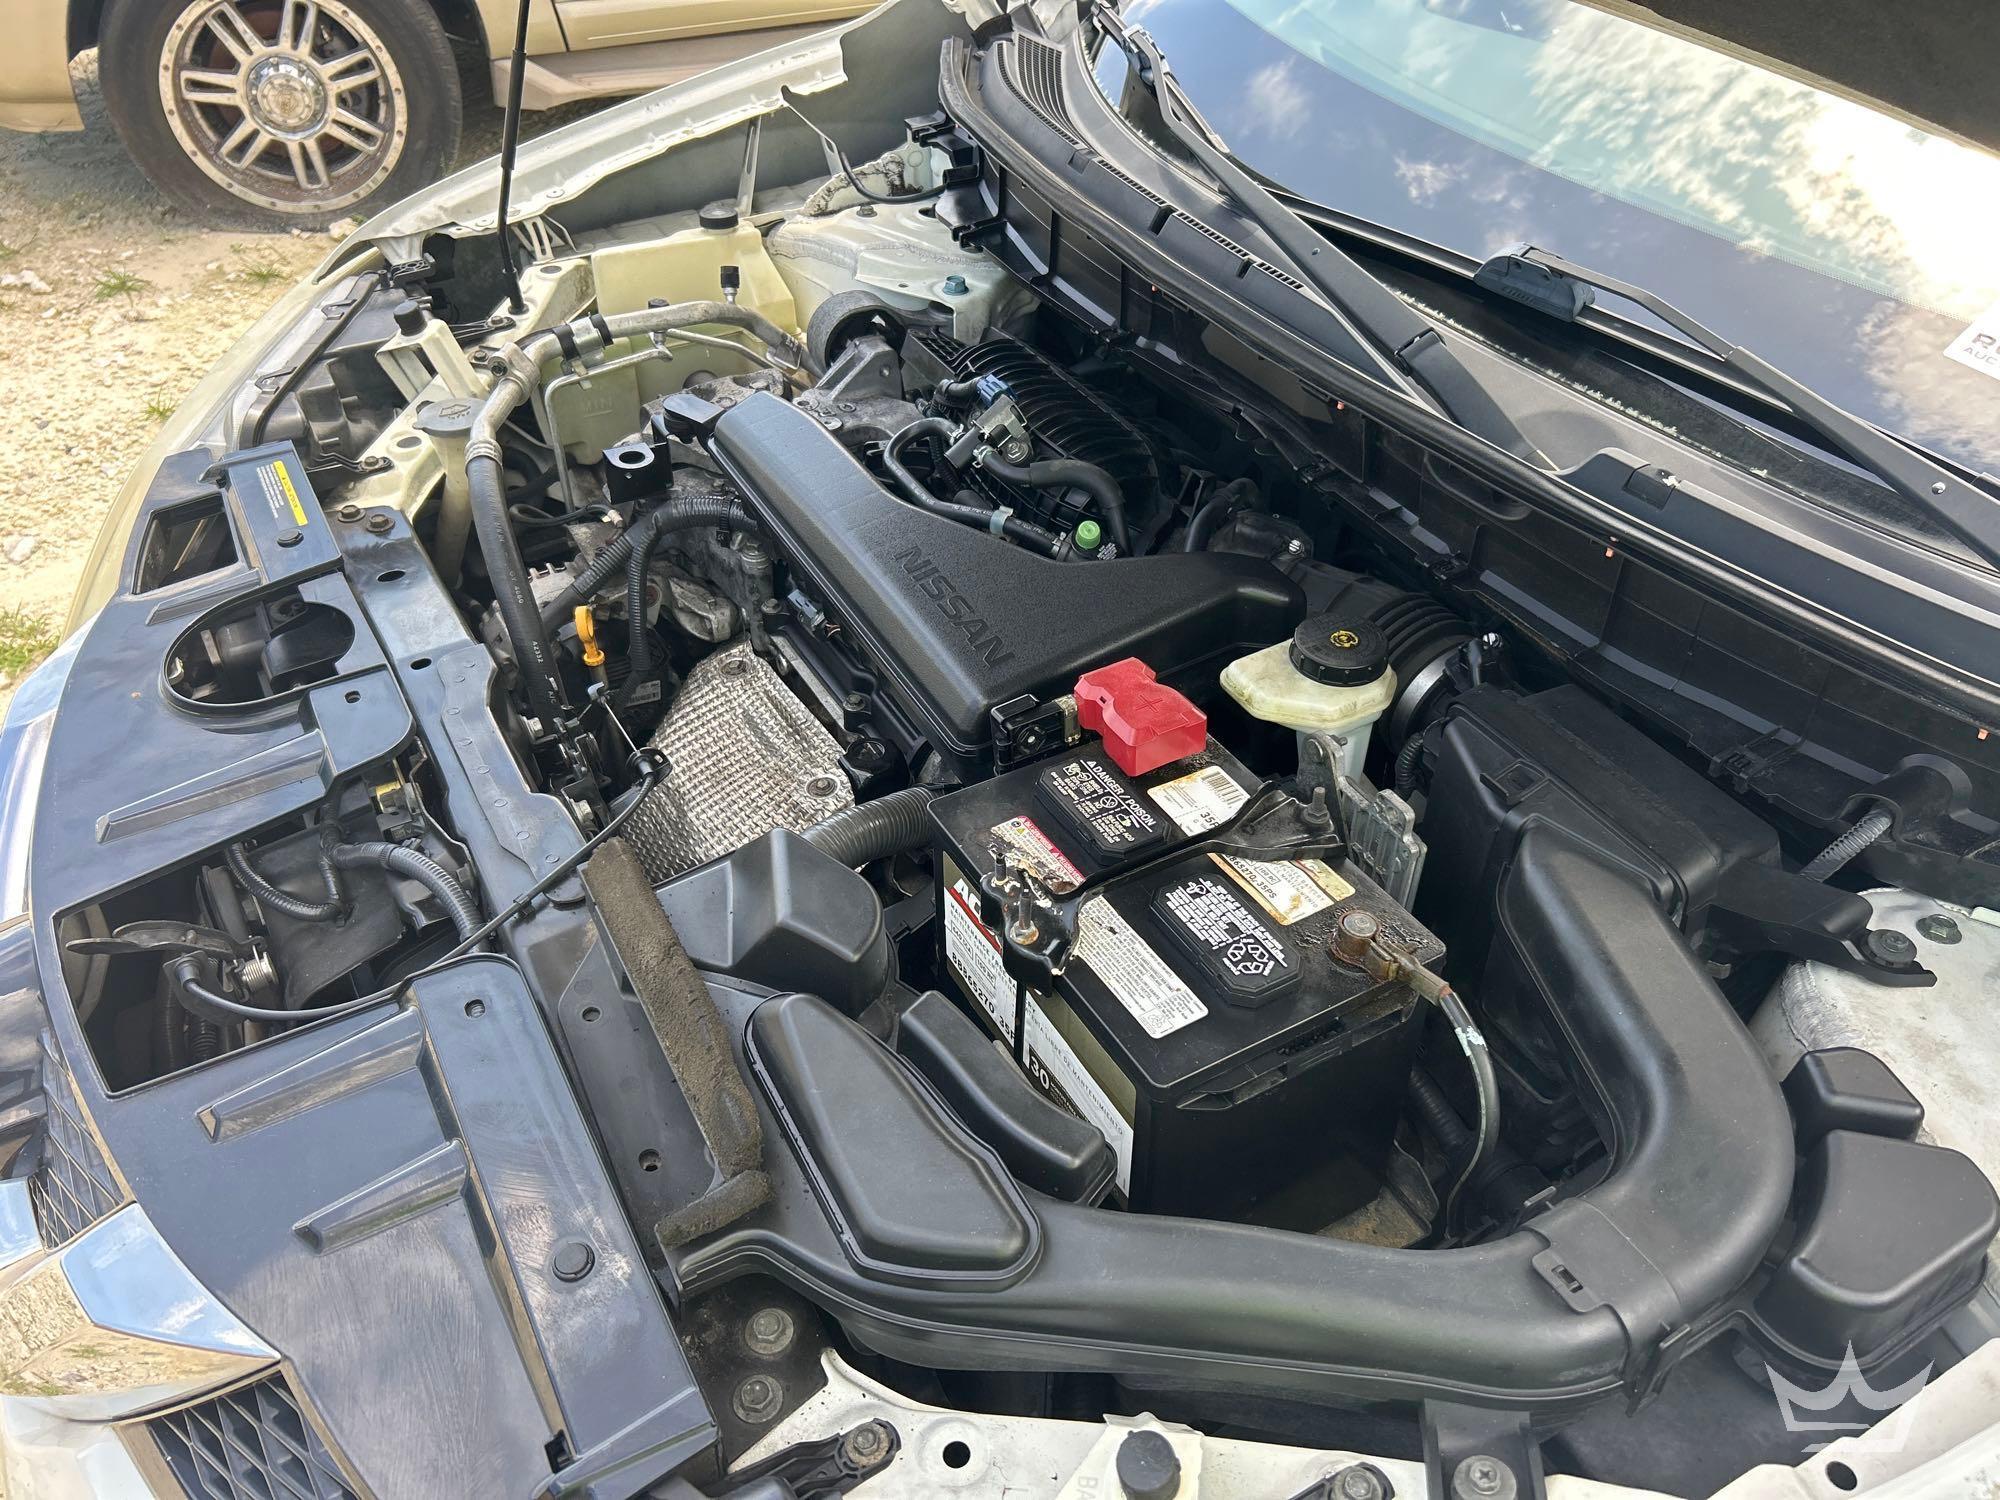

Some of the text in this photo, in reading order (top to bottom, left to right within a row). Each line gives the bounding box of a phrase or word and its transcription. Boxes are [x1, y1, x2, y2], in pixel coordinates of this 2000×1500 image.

[1963, 346, 2000, 368] AUC
[892, 545, 1015, 671] NISSAN
[1094, 766, 1125, 795] DANGER
[1125, 798, 1157, 827] POISON
[1199, 811, 1220, 828] 35P
[1225, 854, 1277, 899] 865270 35PS
[950, 902, 989, 955] MAINTENANCE
[952, 951, 995, 1014] 88865270
[999, 1015, 1015, 1041] 35P
[1029, 1055, 1050, 1091] 30
[1062, 1054, 1070, 1070] DE
[1072, 1068, 1123, 1136] MANTENIMIENTO
